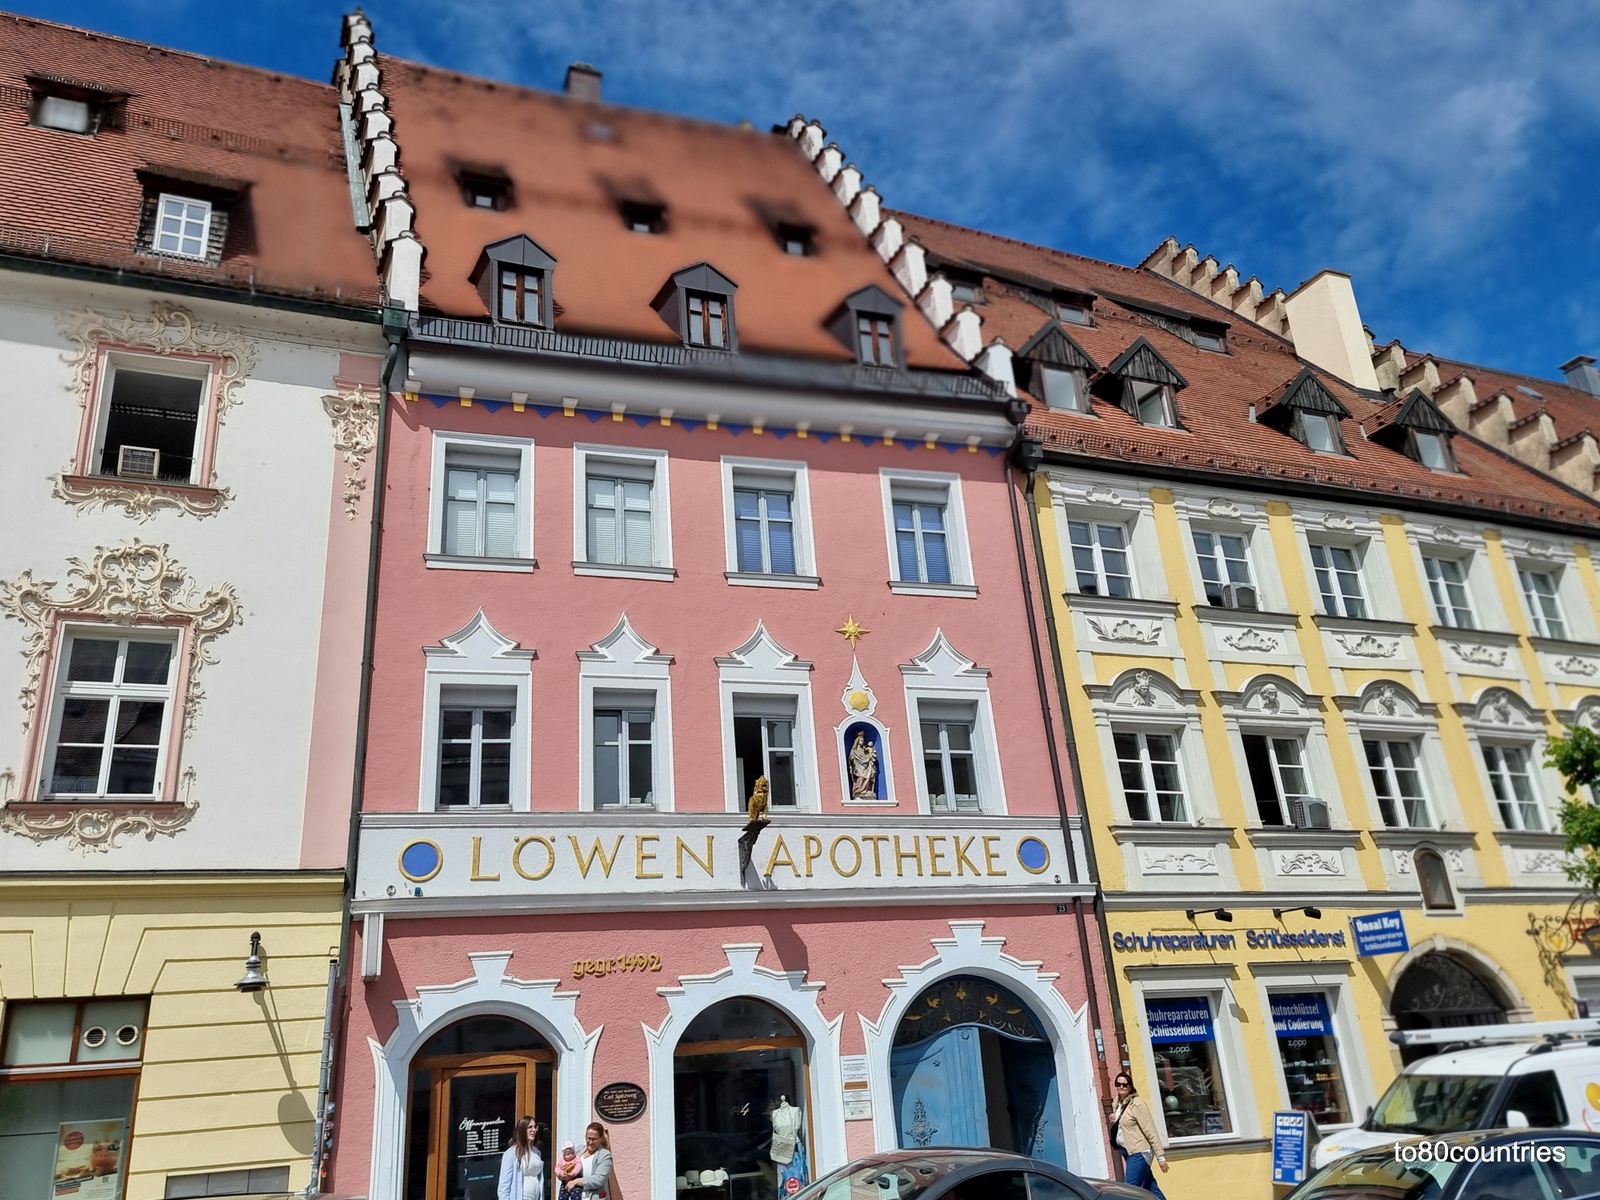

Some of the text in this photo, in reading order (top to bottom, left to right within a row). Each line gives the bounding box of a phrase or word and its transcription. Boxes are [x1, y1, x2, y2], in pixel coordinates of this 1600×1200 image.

[470, 833, 1007, 881] LÖWEN APOTHEKE
[1381, 916, 1400, 930] Key
[1112, 931, 1237, 954] Schuhreparaturen
[1246, 929, 1347, 950] Schlüsseldienst
[618, 953, 662, 973] 1492
[1146, 1009, 1209, 1023] chuhreparaturen
[1271, 1003, 1320, 1016] Autoschlüssel
[1149, 1023, 1207, 1038] Schlüsseldienst
[1274, 1018, 1325, 1032] und Codierung
[1291, 1128, 1303, 1138] Key
